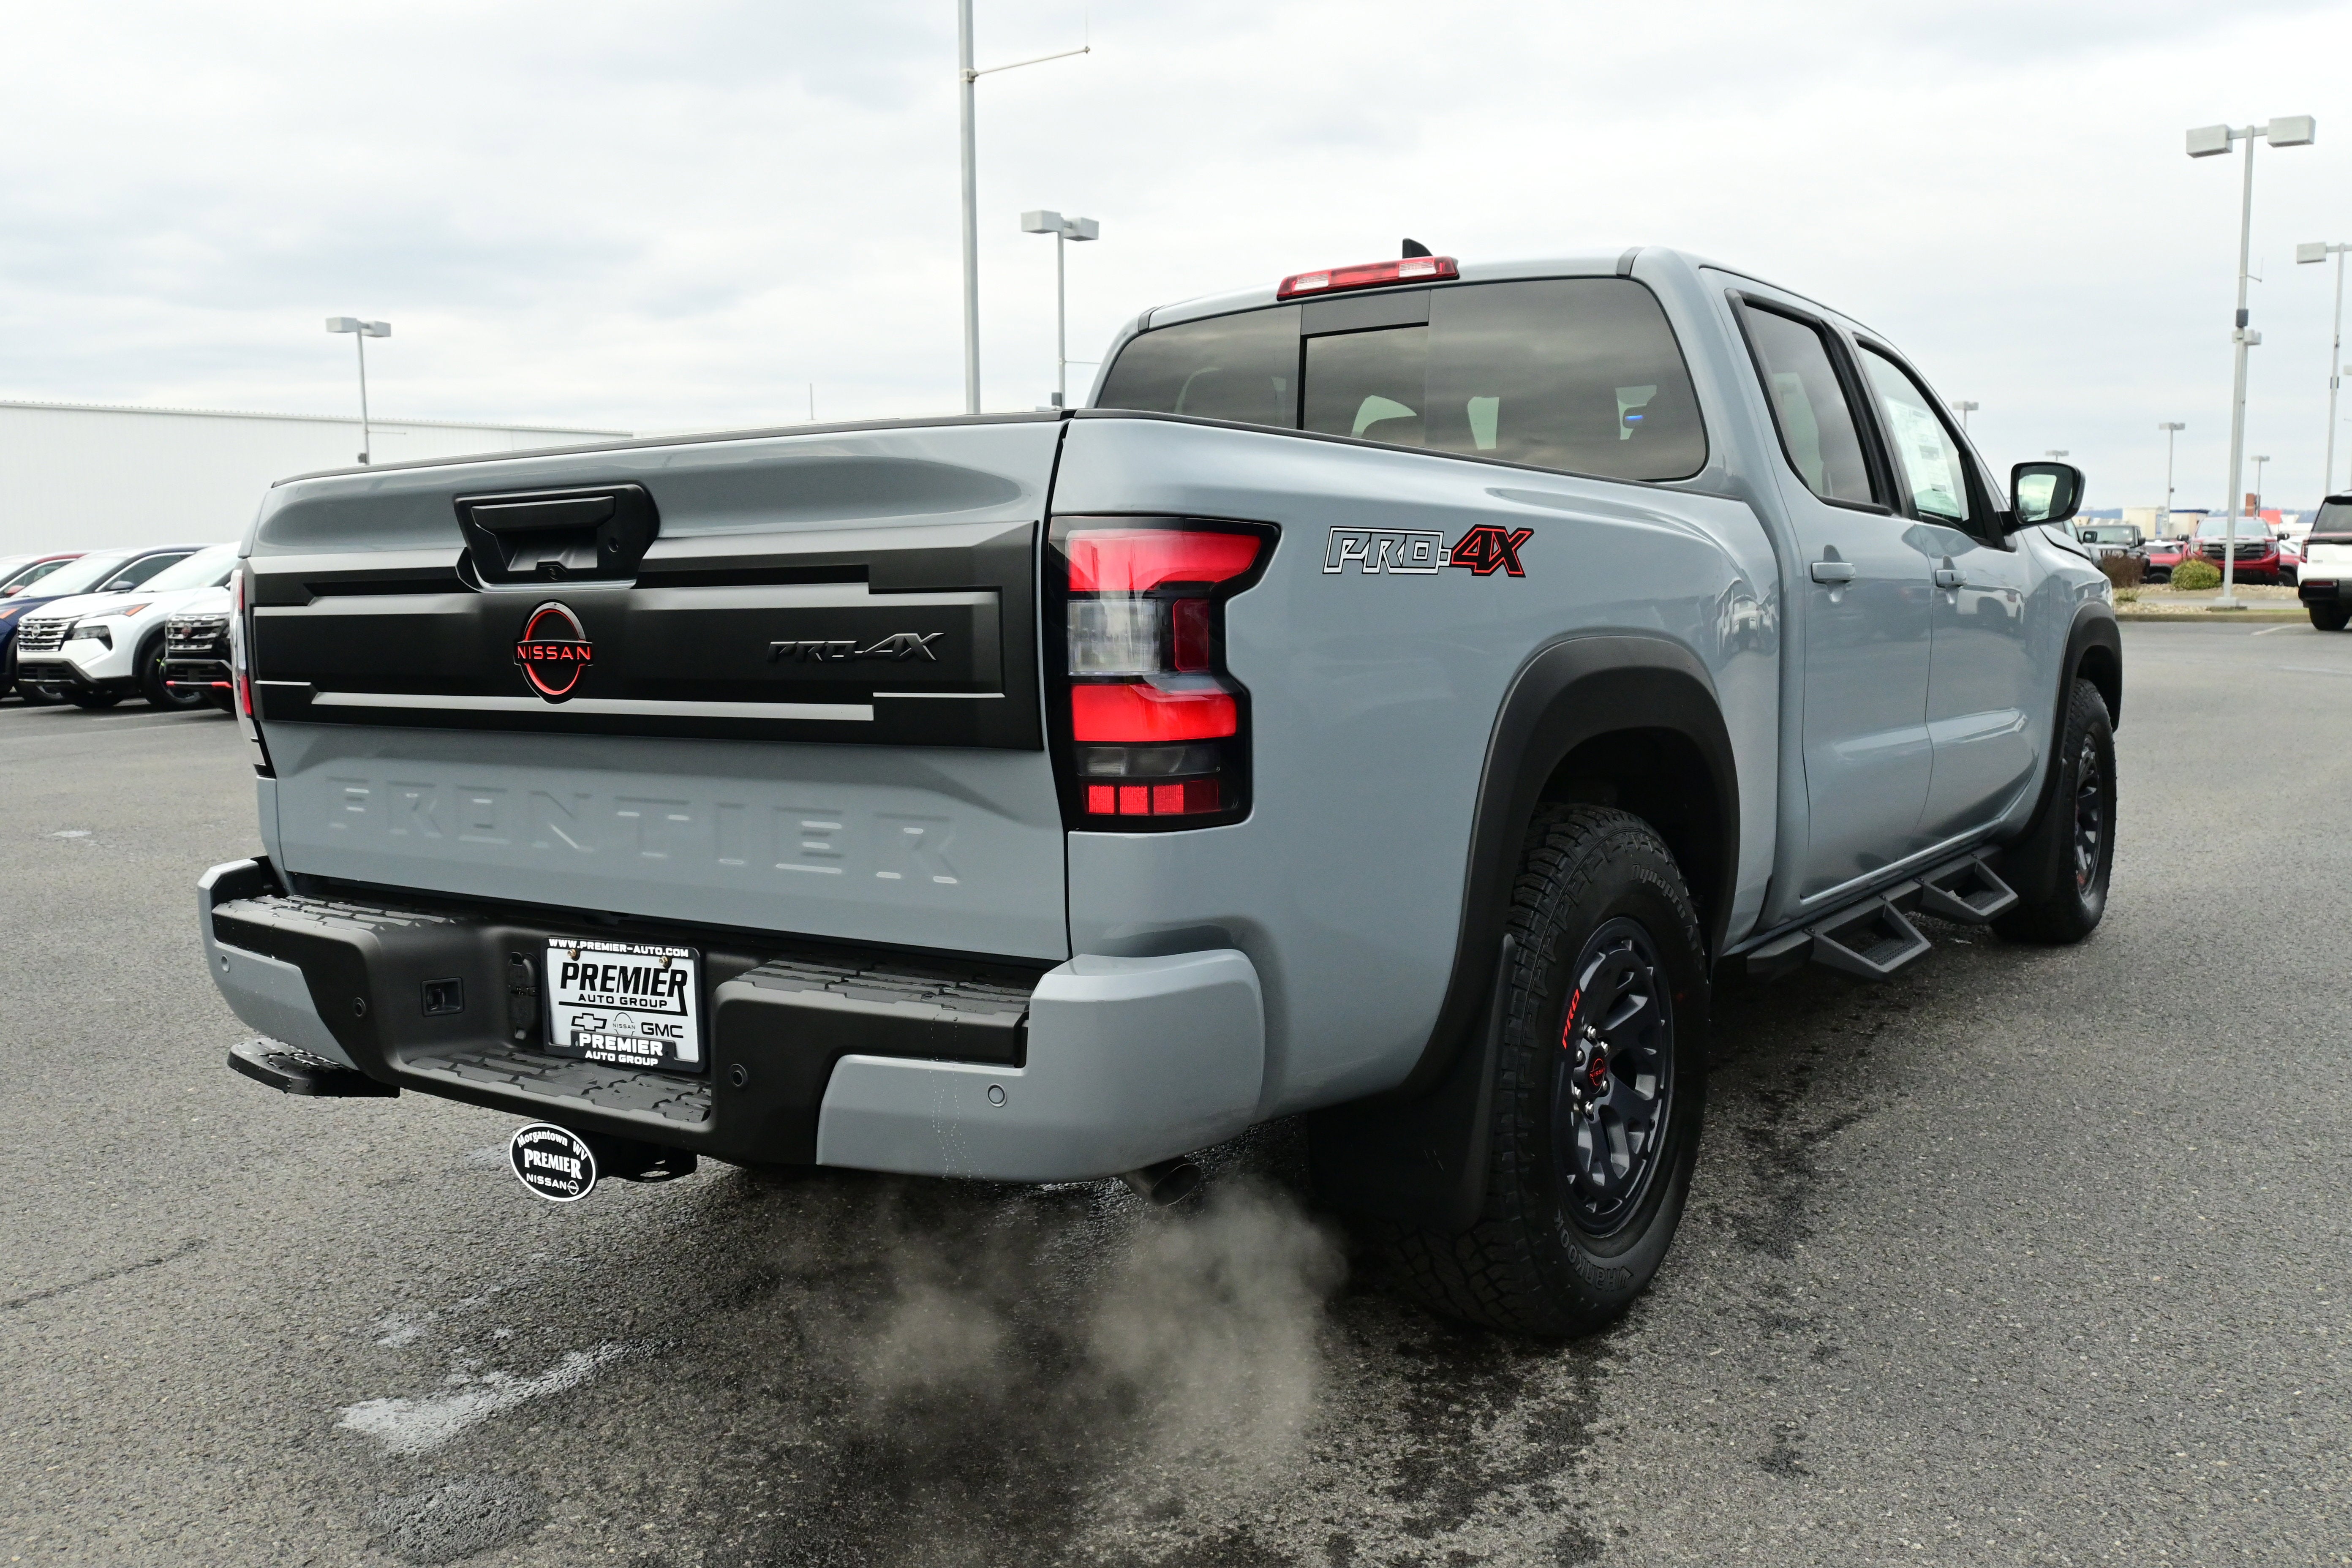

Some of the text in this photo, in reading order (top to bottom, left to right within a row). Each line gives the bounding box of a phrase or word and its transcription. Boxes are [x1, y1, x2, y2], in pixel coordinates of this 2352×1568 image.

[517, 645, 591, 660] NISSAN
[325, 777, 961, 885] FRONTIER
[1631, 863, 1686, 919] Dynapro
[549, 939, 689, 957] WWW.PREMIER-AUTO.COM
[560, 962, 688, 1016] PREMIER
[578, 993, 667, 1008] AUTO GROUP
[641, 1022, 684, 1039] GMC
[1562, 988, 1580, 1050] PRO
[579, 1032, 663, 1056] PREMIER
[585, 1050, 658, 1066] AUTO GROUP
[517, 1130, 588, 1161] Morgantown WV
[524, 1148, 583, 1180] PREMIER
[526, 1173, 566, 1190] NISSAN
